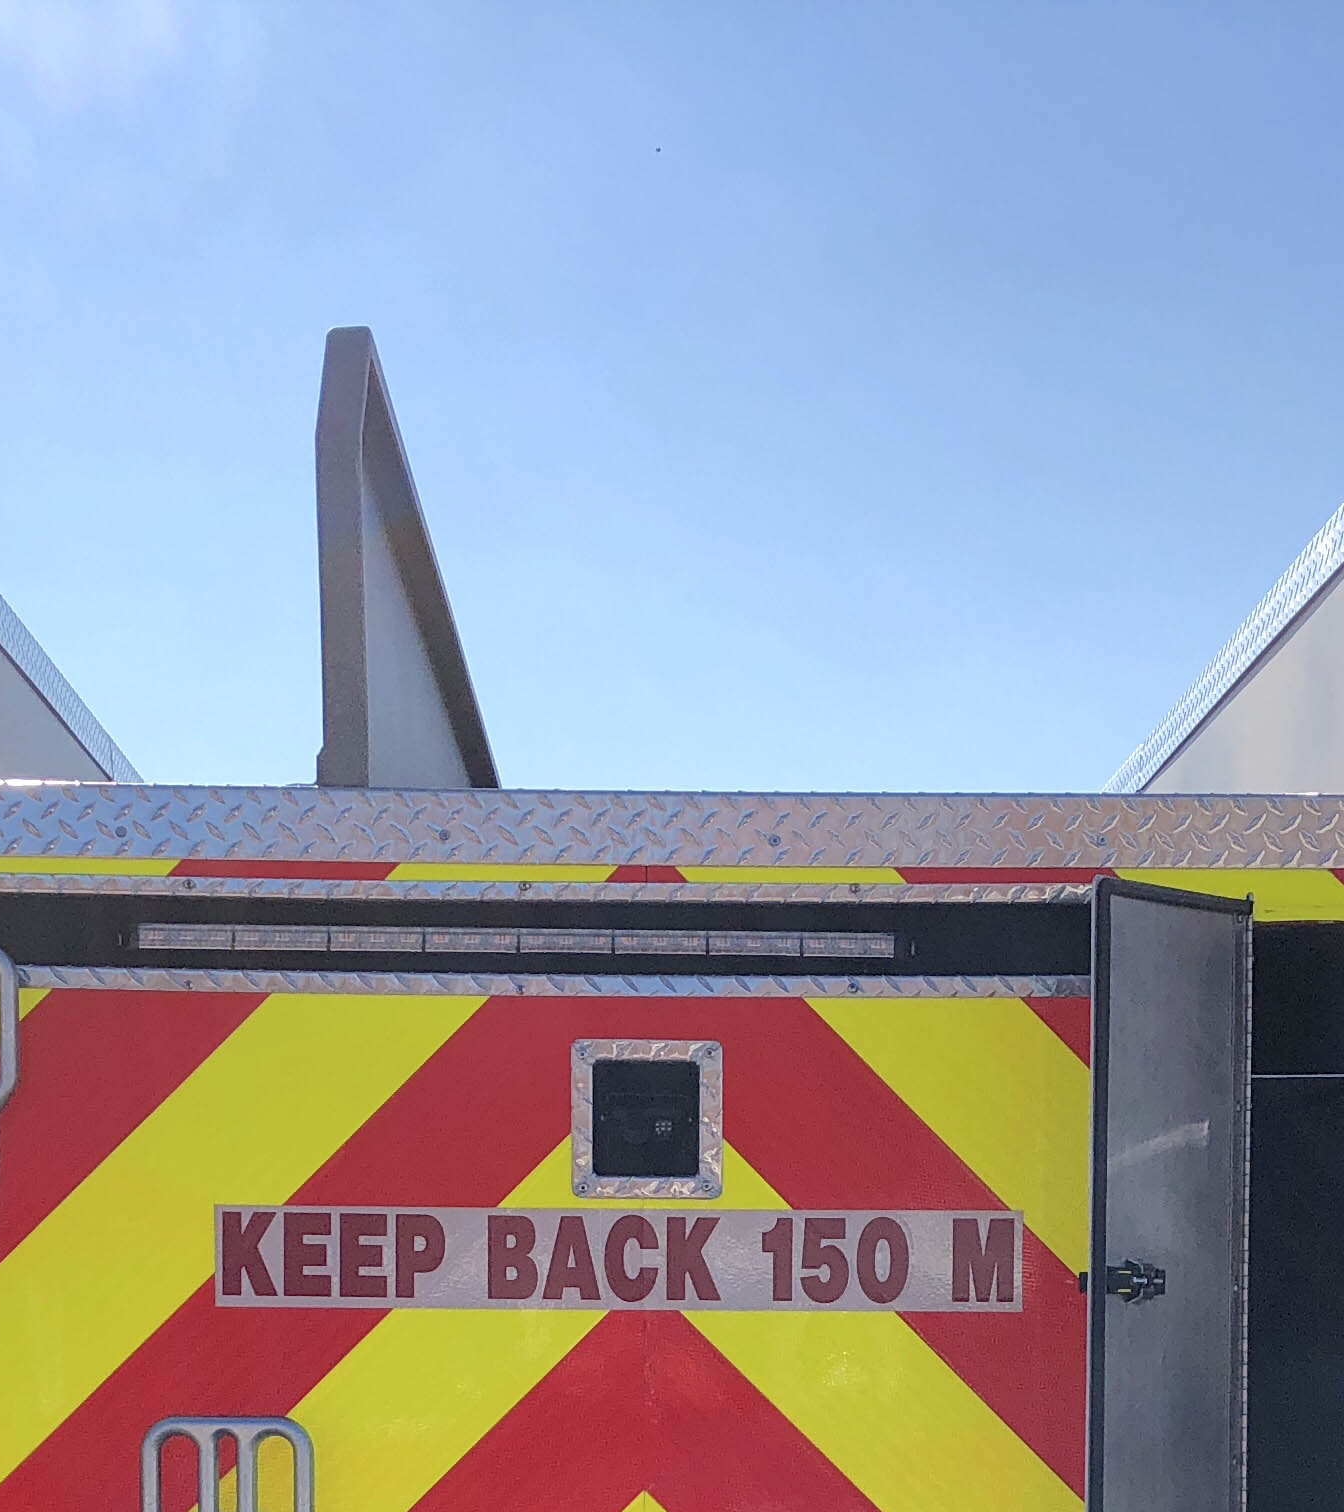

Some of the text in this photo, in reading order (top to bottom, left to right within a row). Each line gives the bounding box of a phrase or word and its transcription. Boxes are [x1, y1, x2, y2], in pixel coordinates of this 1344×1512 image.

[221, 1211, 1016, 1304] KEEP BACK 150 M
